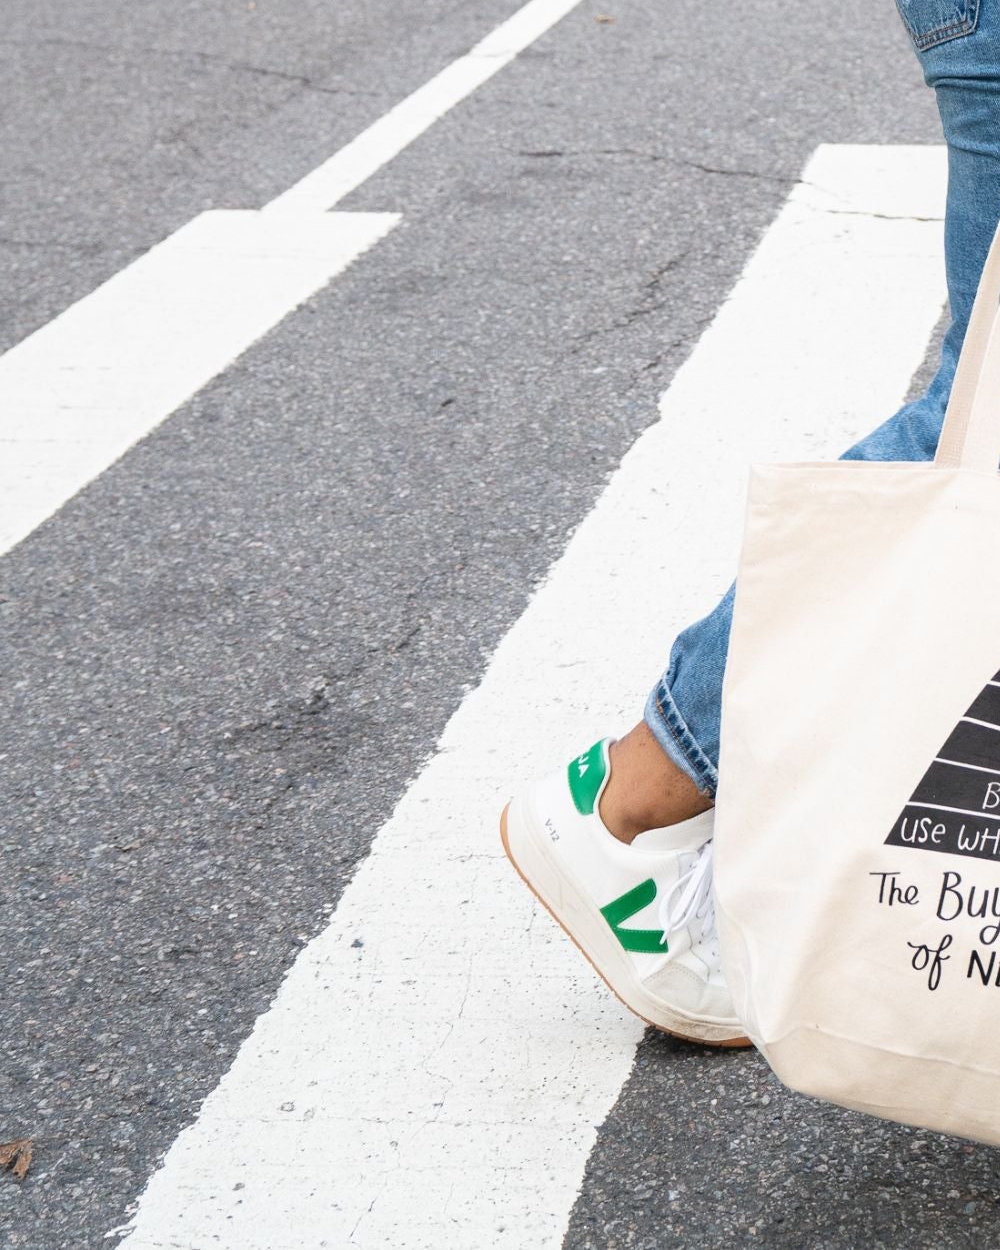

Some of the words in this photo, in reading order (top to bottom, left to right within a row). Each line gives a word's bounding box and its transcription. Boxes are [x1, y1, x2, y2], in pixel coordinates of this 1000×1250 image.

[544, 818, 560, 842] V-12
[869, 872, 919, 906] The
[907, 934, 953, 991] of
